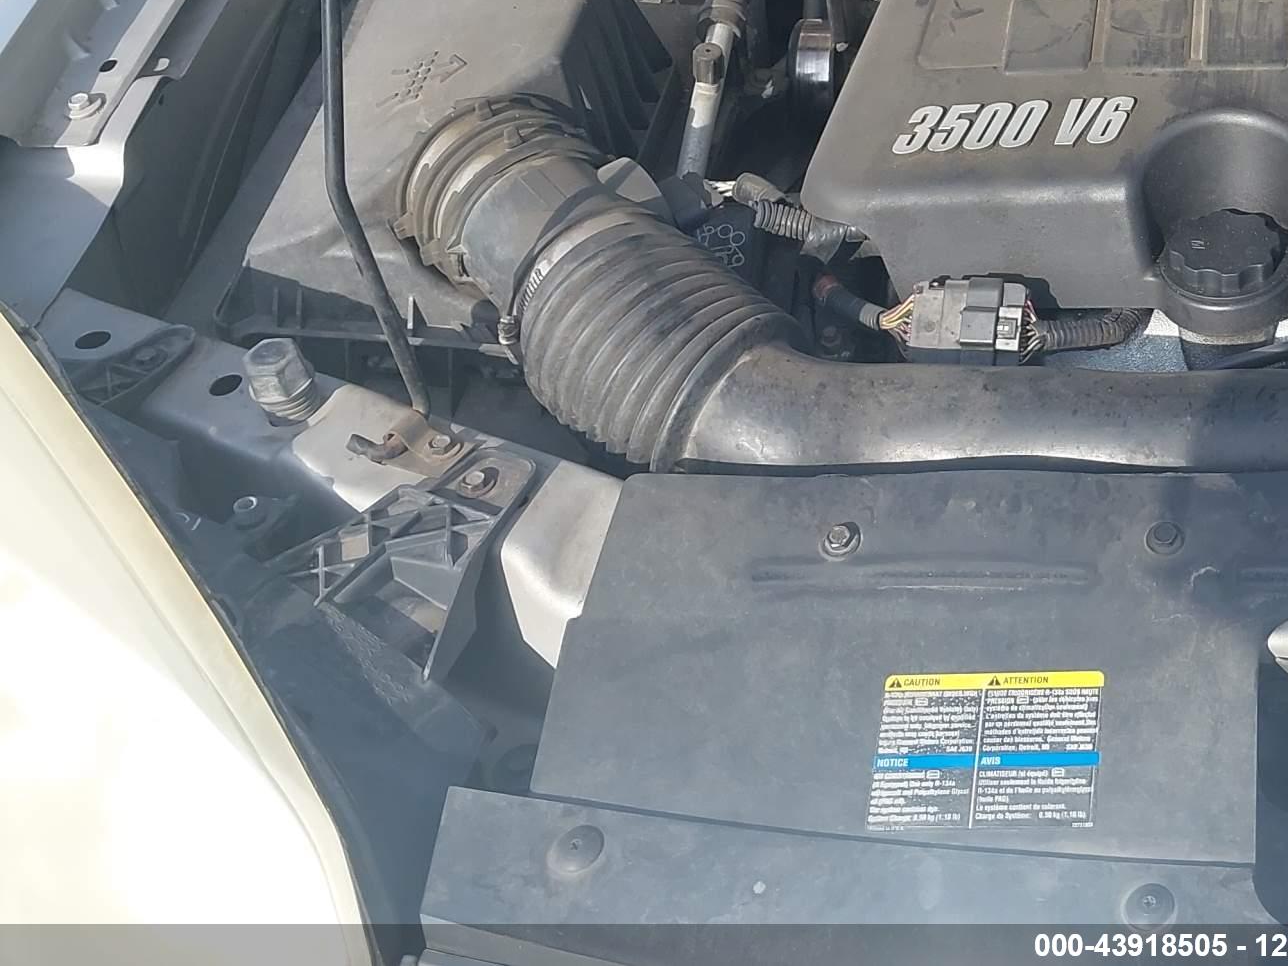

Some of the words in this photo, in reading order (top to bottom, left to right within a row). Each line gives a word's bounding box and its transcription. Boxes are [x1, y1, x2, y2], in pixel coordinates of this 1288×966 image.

[892, 99, 1053, 155] 3500
[1054, 96, 1138, 148] V6
[903, 678, 940, 686] CAUTION
[1003, 676, 1049, 684] ATTENTION
[877, 758, 908, 767] NOTICE
[980, 757, 1001, 765] AVIS
